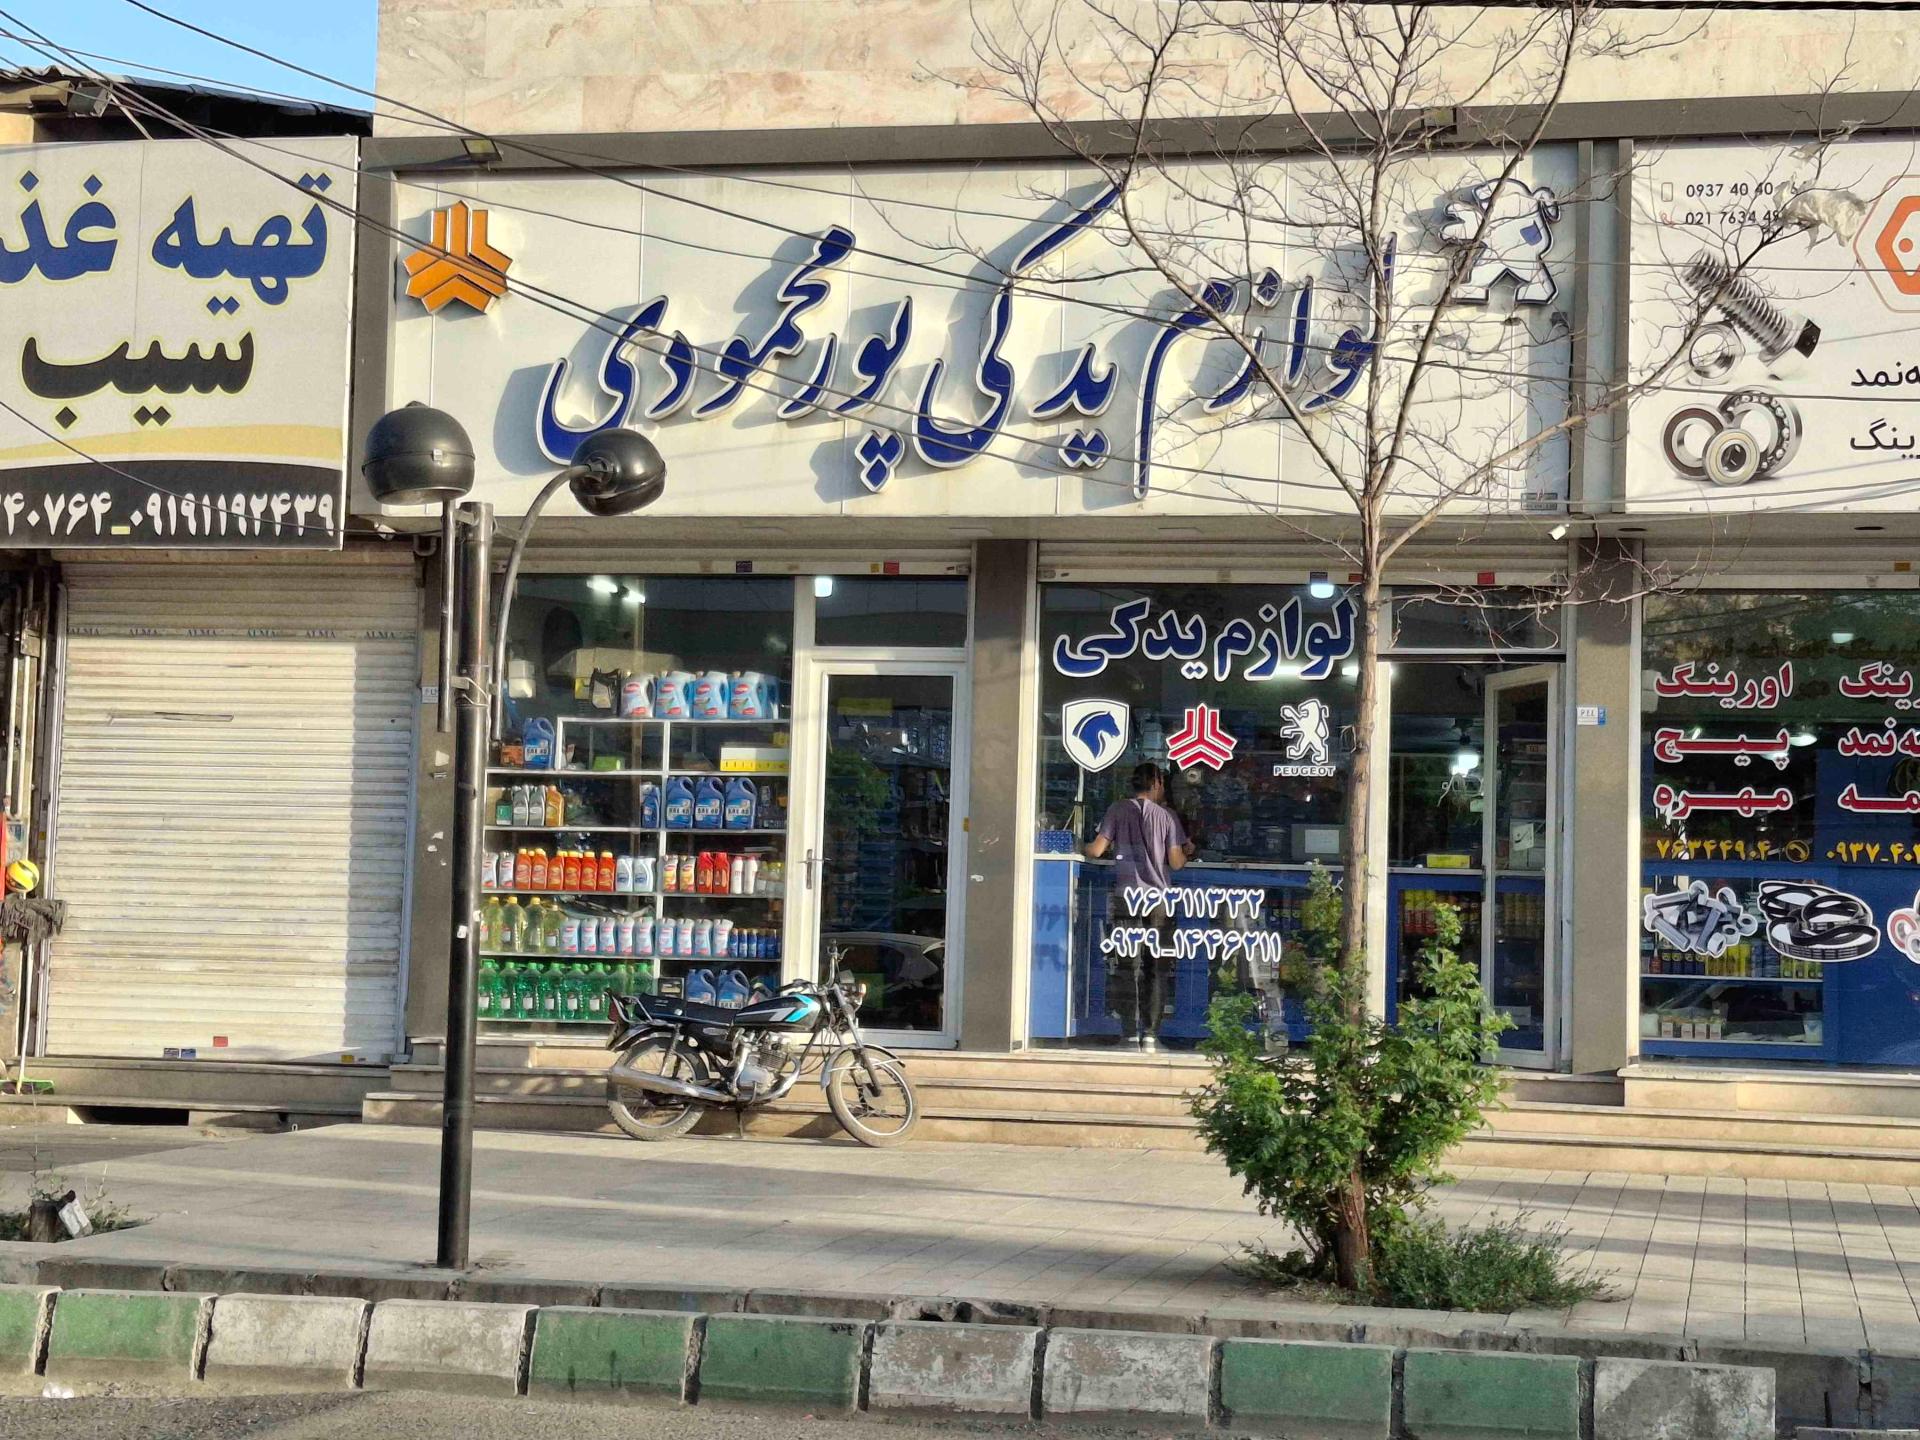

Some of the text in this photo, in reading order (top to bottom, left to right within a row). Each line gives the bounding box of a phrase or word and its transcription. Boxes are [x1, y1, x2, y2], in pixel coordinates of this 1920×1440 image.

[1686, 183, 1723, 197] 0937
[1730, 183, 1748, 196] 40
[1685, 212, 1711, 225] 021
[1720, 211, 1756, 224] 7634
[152, 172, 332, 315] تهیه
[912, 182, 1124, 470] یدکی
[22, 332, 254, 429] سیب
[1133, 231, 1397, 499] لوازم
[1053, 596, 1358, 681] لوازم یدکی
[1654, 661, 1793, 709] اورینگ
[1654, 726, 1790, 770] پیچ
[1274, 765, 1336, 777] PEUGEOT
[1653, 784, 1793, 819] مهره
[1657, 839, 1771, 861] ۷۶۳۴۴۹۰۴
[1124, 886, 1266, 919] ۷۶۳۱۱۳۳۲
